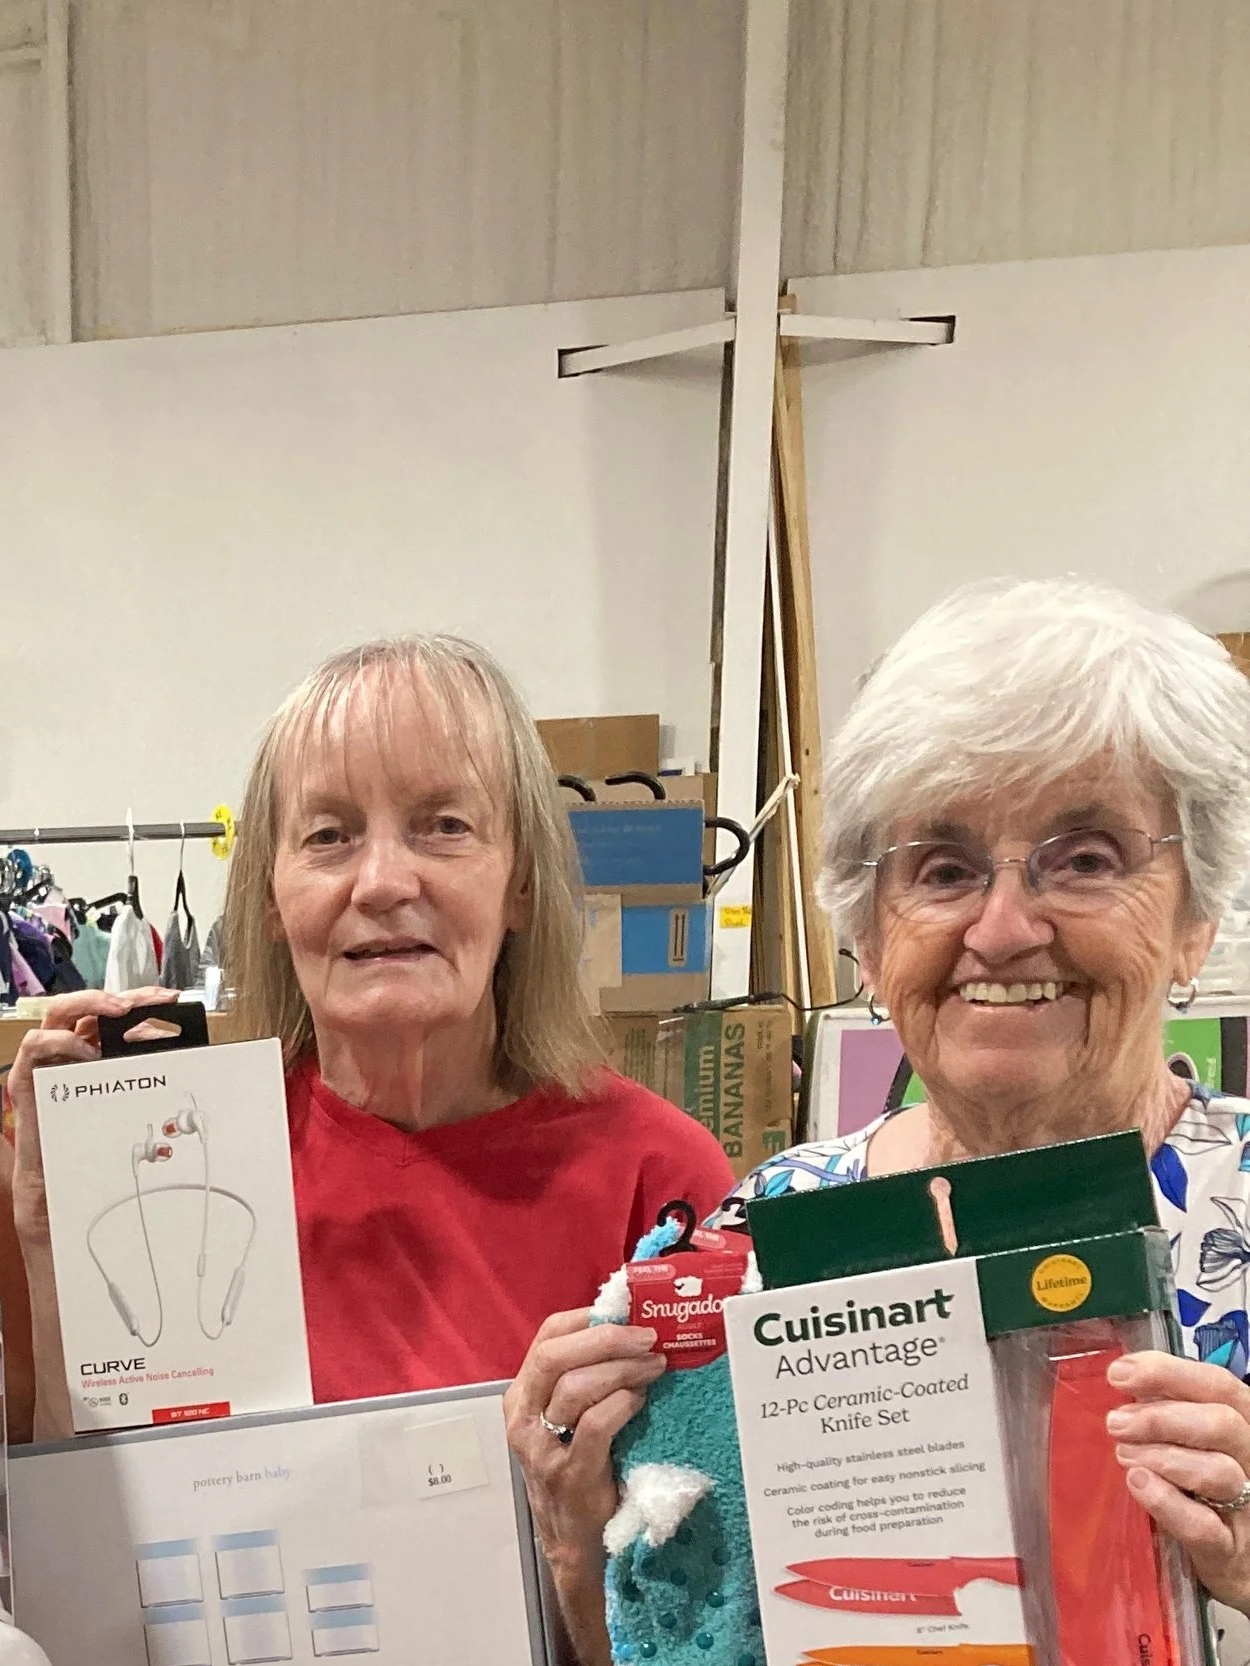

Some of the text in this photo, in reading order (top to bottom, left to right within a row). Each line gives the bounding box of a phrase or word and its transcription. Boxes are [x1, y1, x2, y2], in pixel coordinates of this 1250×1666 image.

[75, 1075, 166, 1098] PHIATON
[694, 1045, 714, 1131] emium
[723, 1022, 746, 1158] BANANAS
[1036, 1276, 1087, 1291] Lifetime
[754, 1288, 955, 1346] Cuisinart
[662, 1338, 716, 1348] CHAUSSETTES
[676, 1332, 703, 1342] SOCKS
[80, 1357, 146, 1376] CURVE
[81, 1366, 214, 1388] Wireless Active Noise Cancelling
[761, 1373, 970, 1418] 12-Pc Ceramic-Coated
[821, 1408, 910, 1434] Knife Set
[777, 1440, 965, 1474] High-quality stainless steel blades
[193, 1466, 292, 1492] pottery barn baby
[428, 1474, 452, 1487] $8.00
[764, 1461, 986, 1498] Ceramic coating for easy nonstick slicing
[786, 1486, 966, 1517] Color coding helps you to reduce
[792, 1500, 965, 1528] the risk of cross-contamination
[814, 1515, 944, 1538] during food preparation
